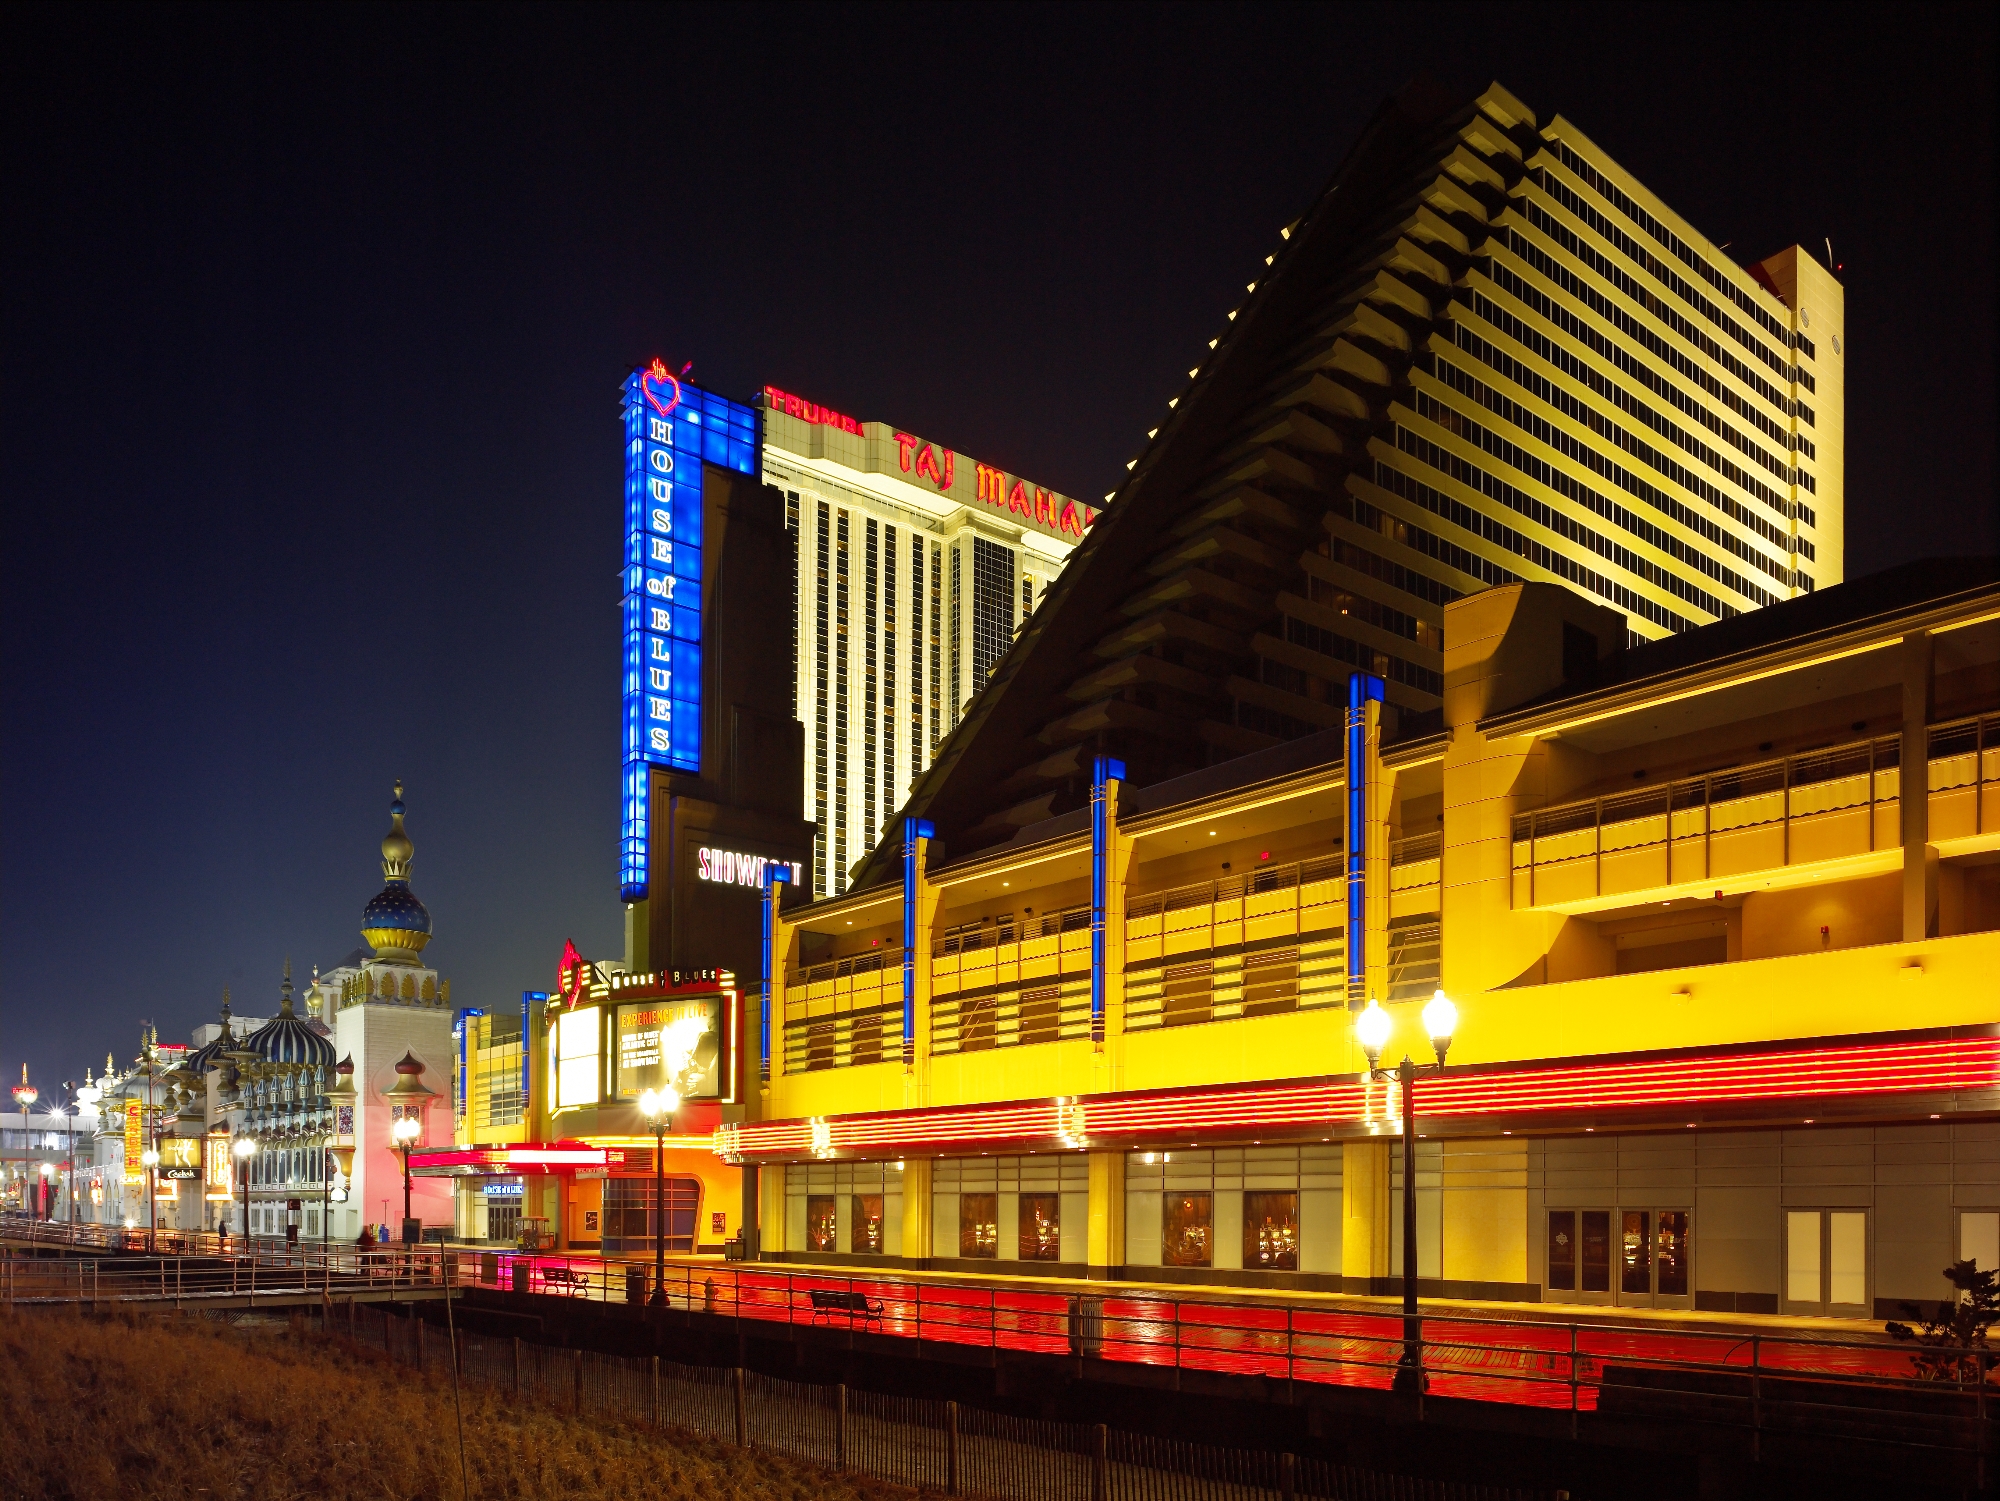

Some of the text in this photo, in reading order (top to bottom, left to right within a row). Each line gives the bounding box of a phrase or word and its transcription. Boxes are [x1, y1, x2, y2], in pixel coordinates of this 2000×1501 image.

[893, 432, 954, 491] TAJ
[646, 417, 677, 751] HOUSE of BLUES
[674, 970, 716, 982] BLUES
[621, 1007, 674, 1028] EXPERIENCE
[687, 1003, 708, 1019] LIVE
[128, 1106, 139, 1166] CASBAH
